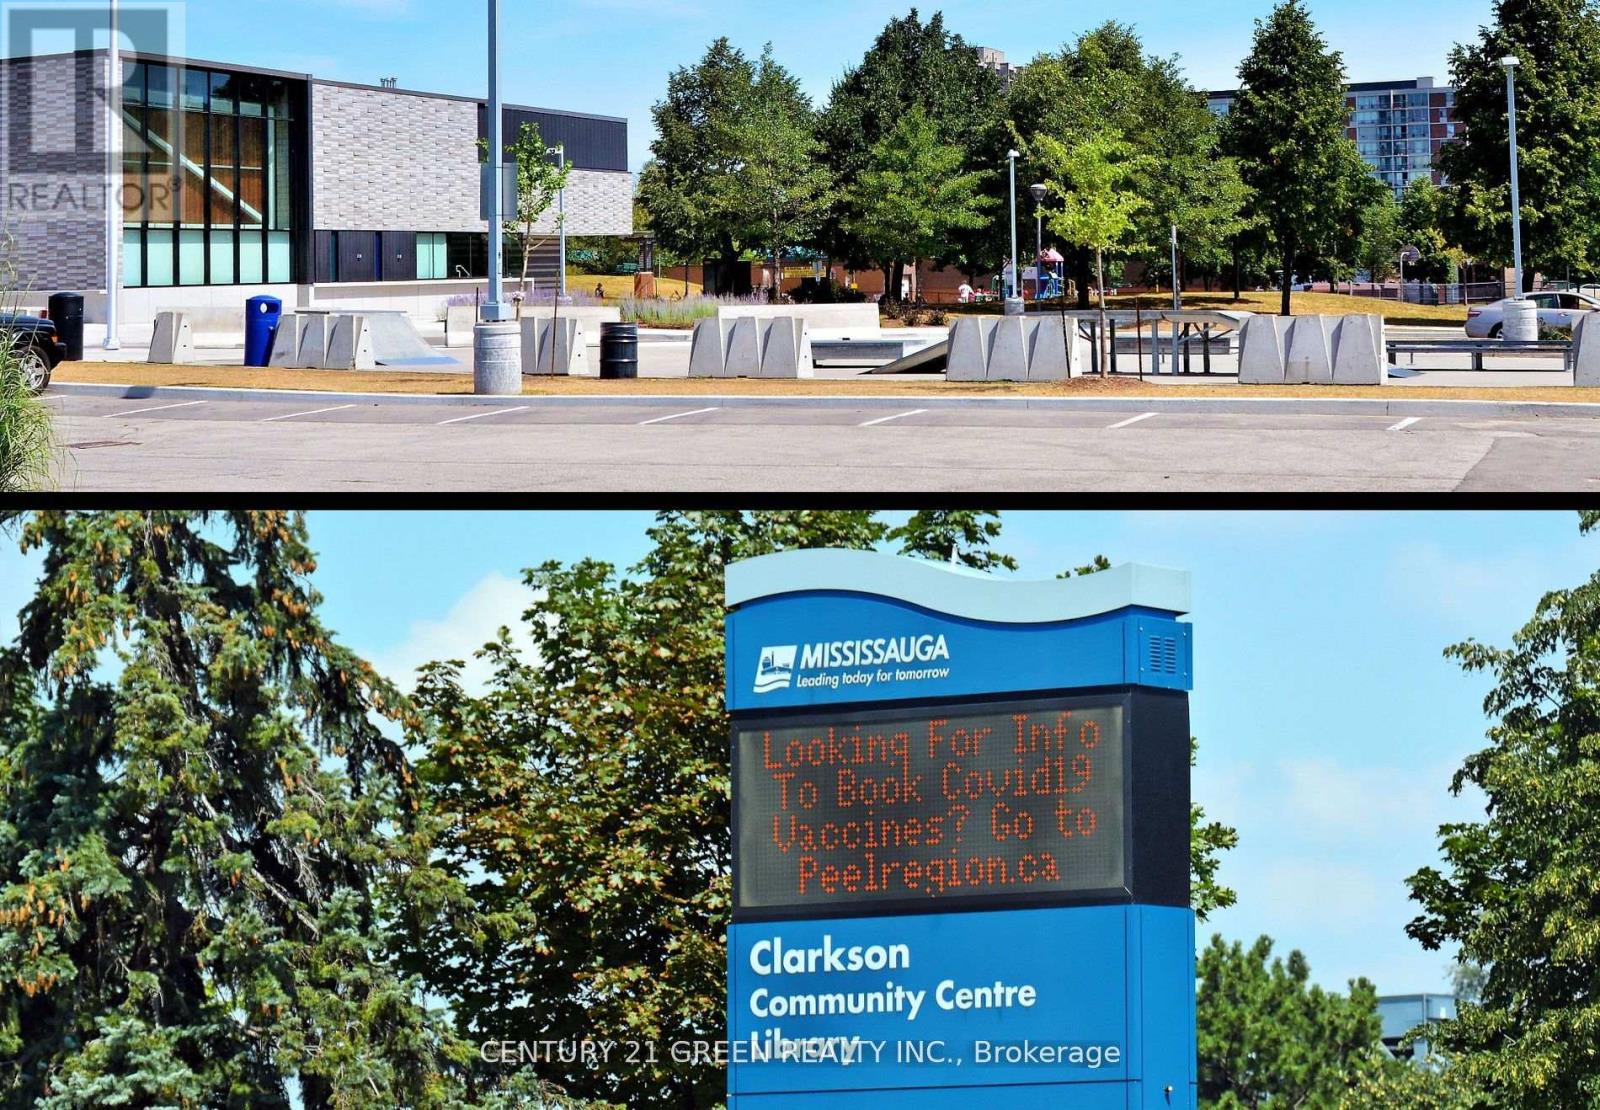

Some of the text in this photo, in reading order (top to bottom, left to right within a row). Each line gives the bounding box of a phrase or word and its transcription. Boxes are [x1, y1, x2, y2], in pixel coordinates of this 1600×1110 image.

[800, 634, 950, 669] MISSISSAUGA
[796, 667, 950, 689] Leading today for tomorrow
[763, 710, 1100, 768] Looking For Info
[772, 753, 1092, 810] To Book Covid19
[773, 799, 1097, 853] Vaccines? Go to
[799, 848, 1061, 895] Peelregion.ca
[749, 935, 910, 975] Clarkson
[749, 980, 1036, 1020] Community Centre
[751, 1027, 860, 1066] Library
